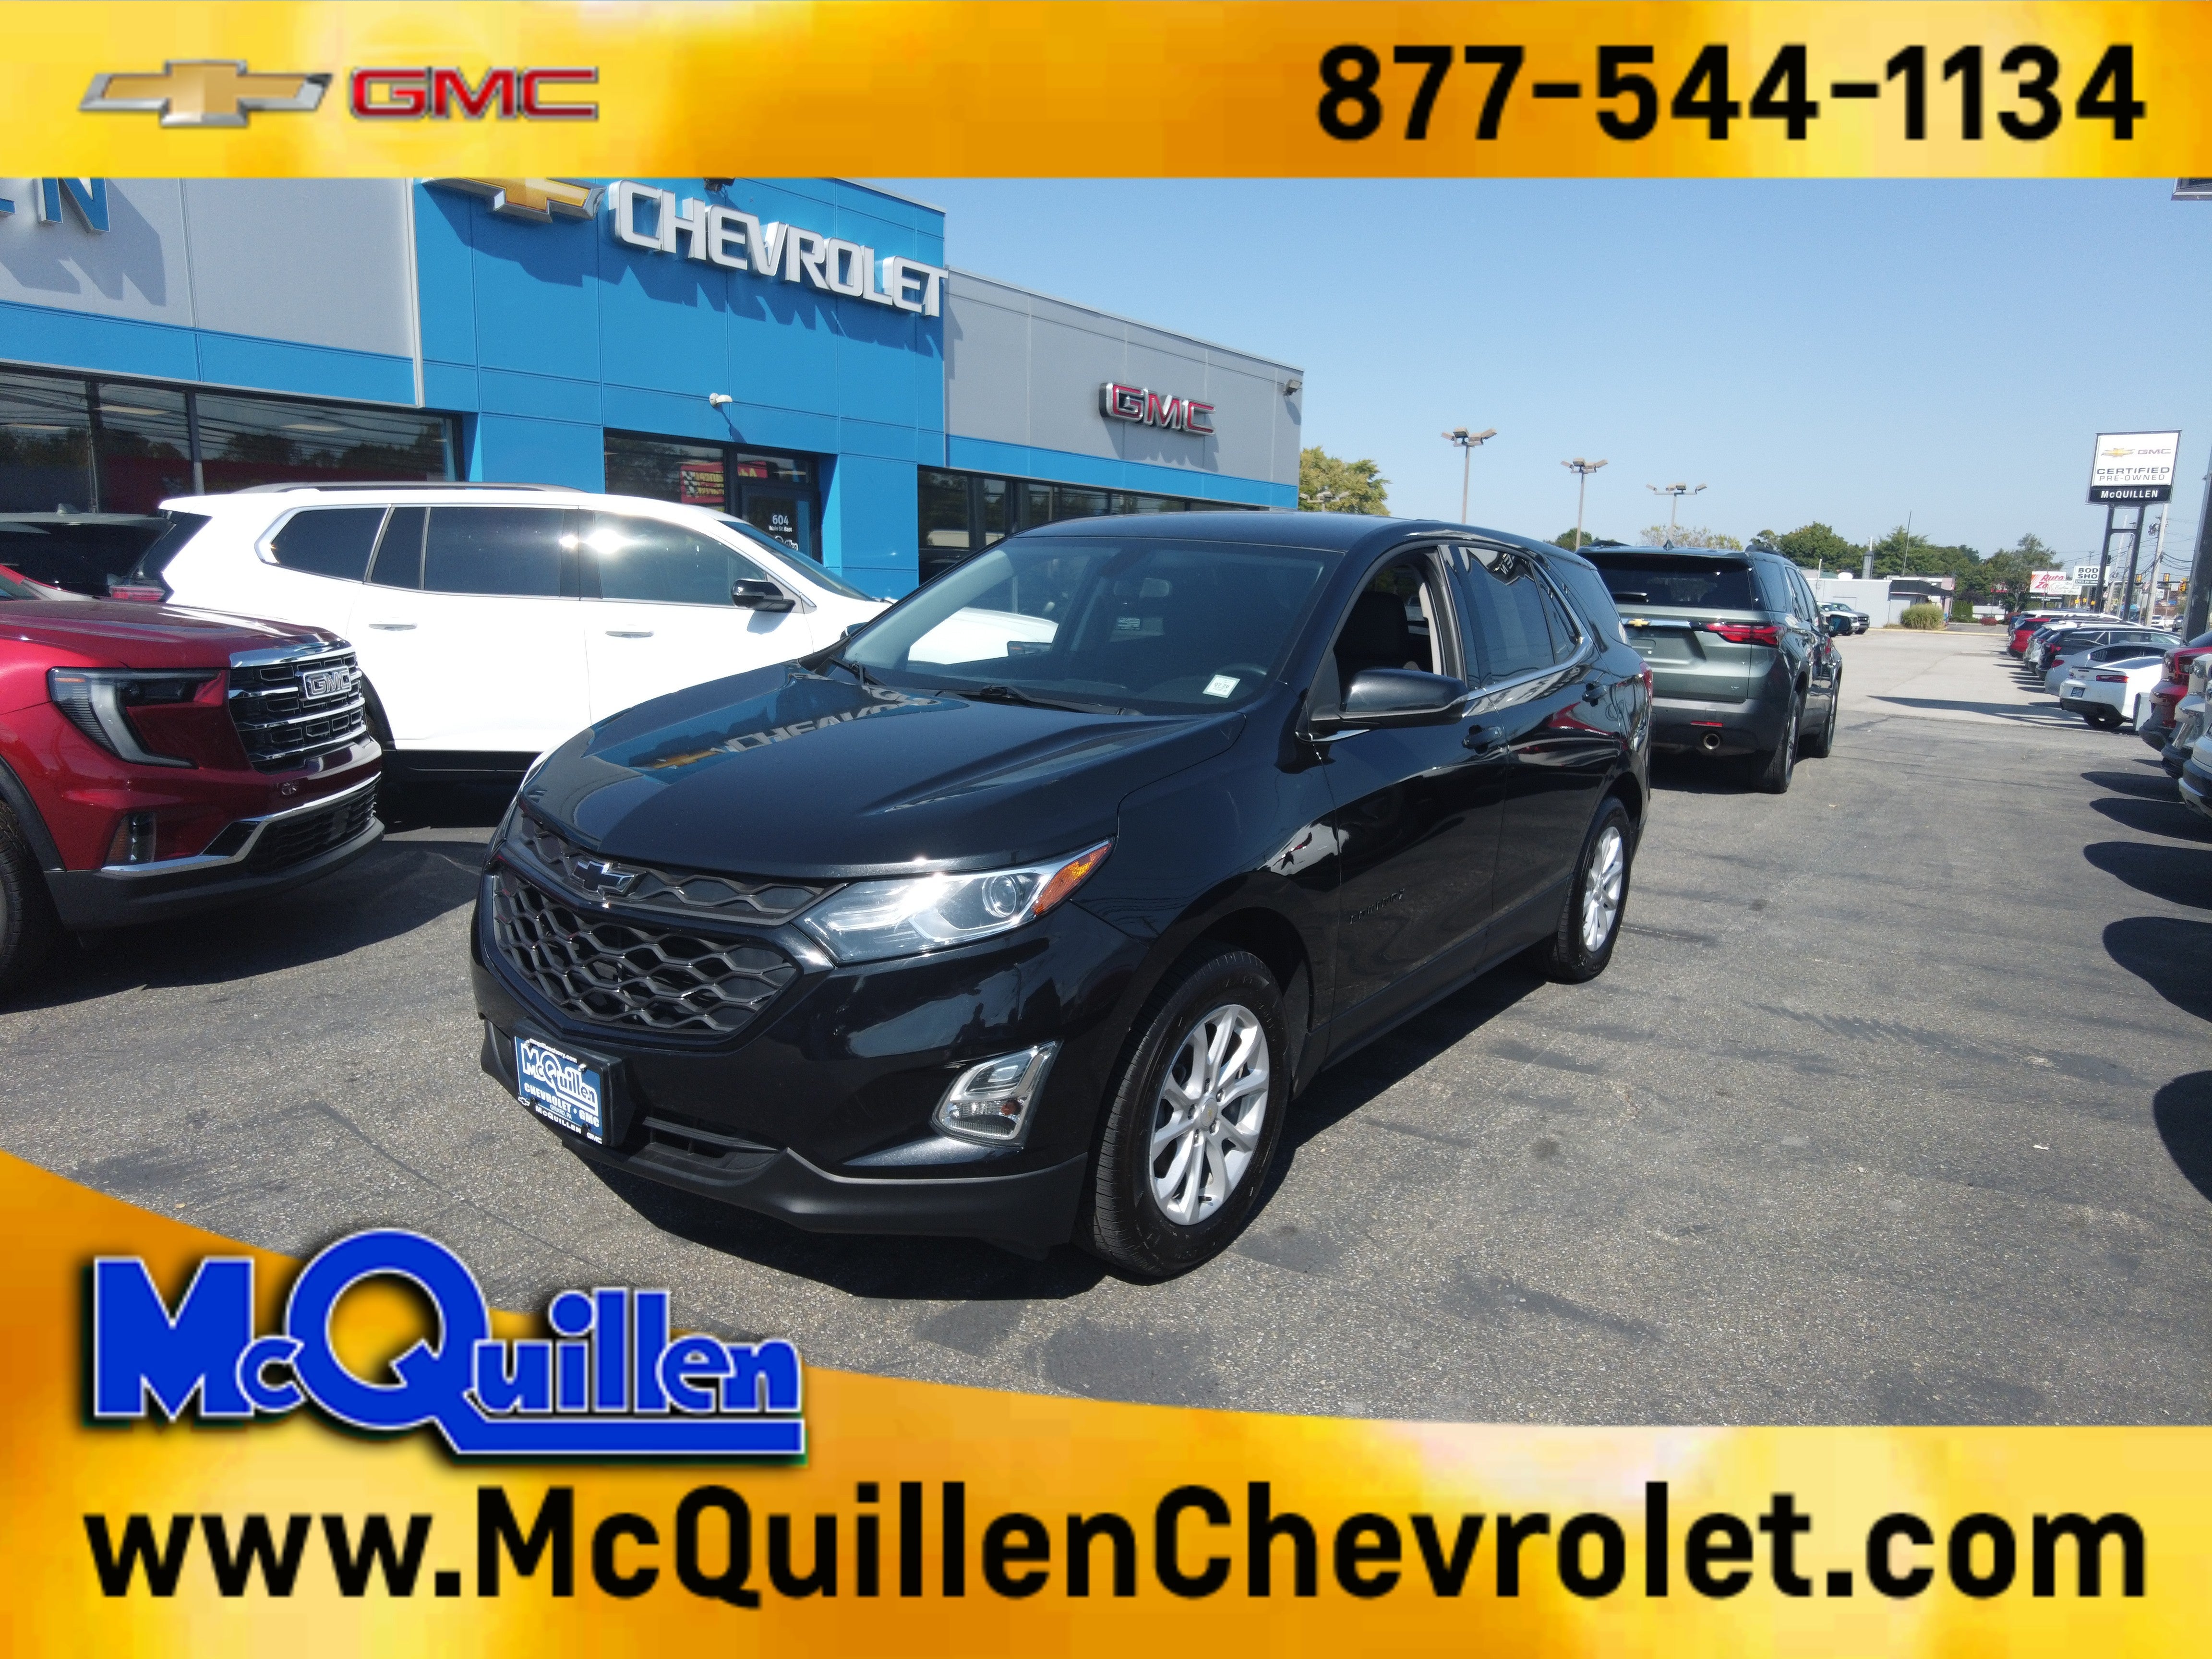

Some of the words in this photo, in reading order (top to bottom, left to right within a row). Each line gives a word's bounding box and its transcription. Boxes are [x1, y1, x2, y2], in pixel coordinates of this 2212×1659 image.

[608, 179, 949, 318] CHEVROLET
[1099, 383, 1216, 436] GMC
[2101, 490, 2158, 499] McQUILLEN
[772, 515, 789, 526] 604
[311, 670, 351, 695] GMC
[520, 1042, 599, 1117] McQuillen
[524, 1082, 572, 1113] CHEVROLET
[579, 1109, 600, 1128] GMC
[535, 1105, 581, 1134] McQUILLEN
[587, 1131, 602, 1144] GMC
